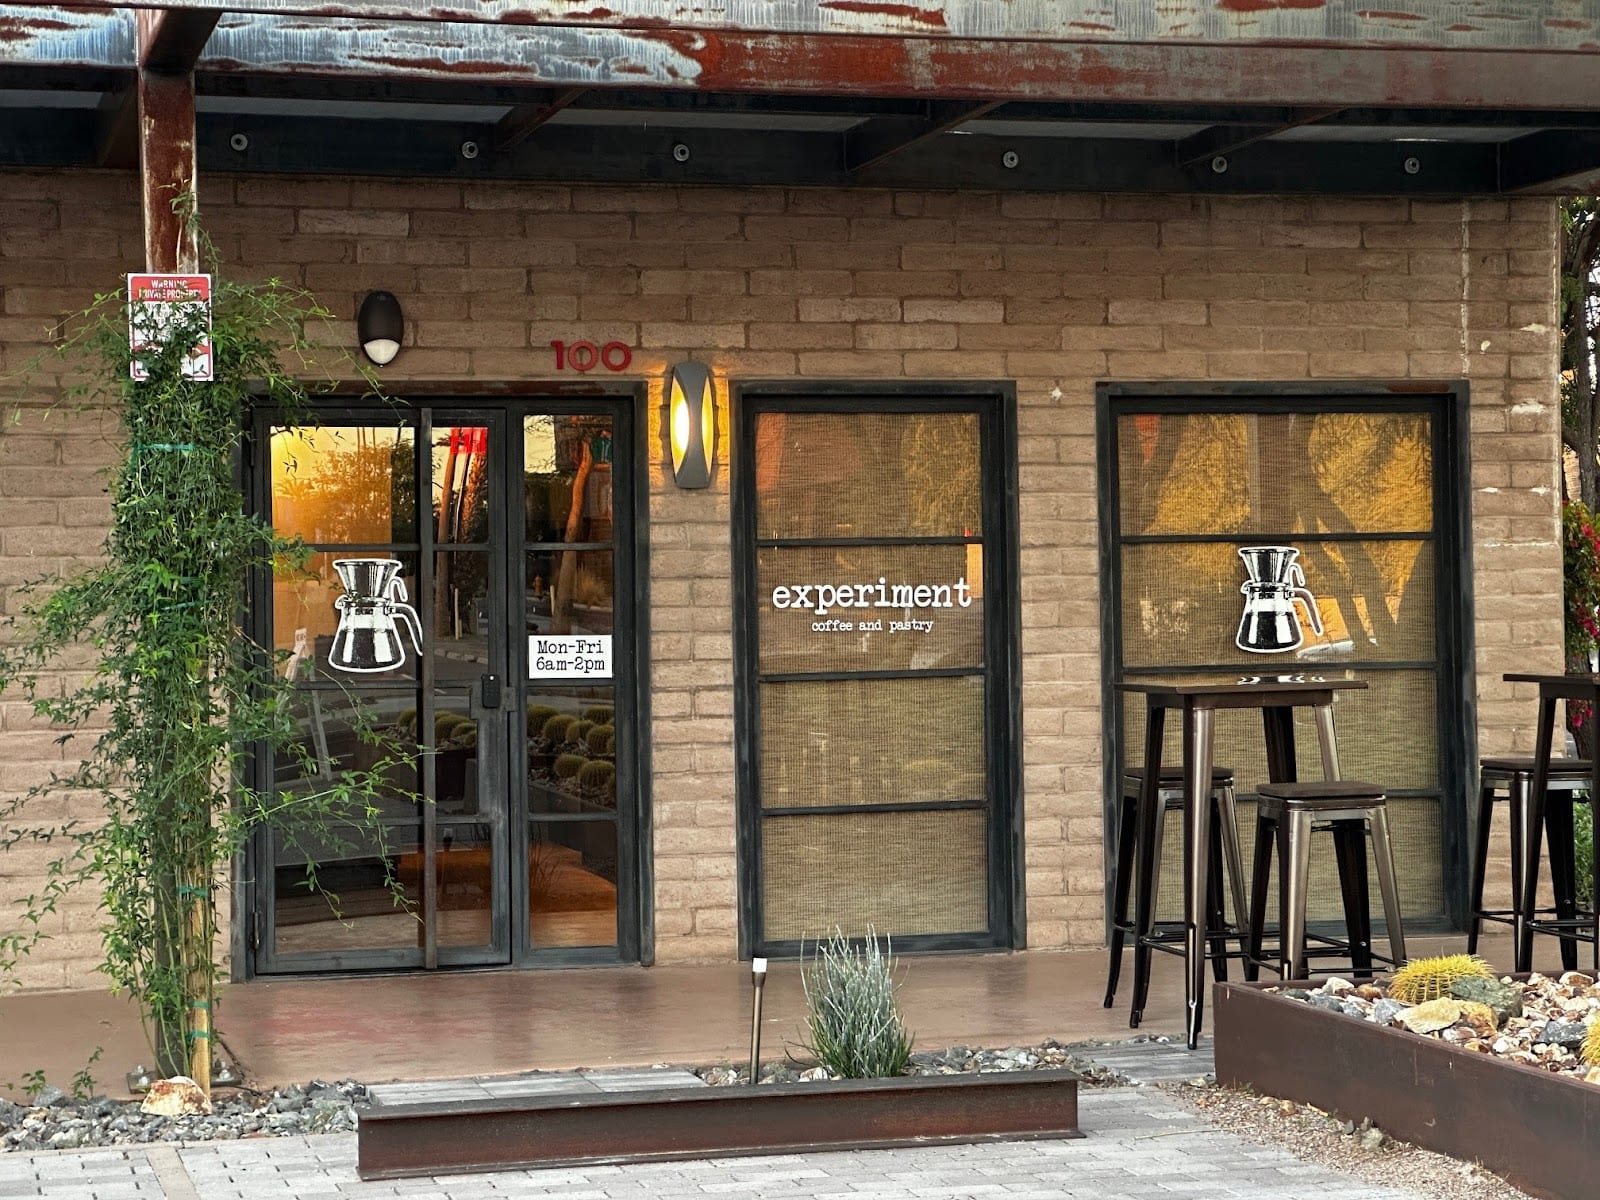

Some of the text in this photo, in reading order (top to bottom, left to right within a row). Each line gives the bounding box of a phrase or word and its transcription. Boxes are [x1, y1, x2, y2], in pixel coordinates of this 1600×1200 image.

[551, 340, 632, 372] 100
[772, 577, 972, 615] experiment
[811, 620, 934, 633] coffee and pastry
[537, 640, 604, 654] Mon-Fri
[536, 656, 605, 674] 6am-2pm
